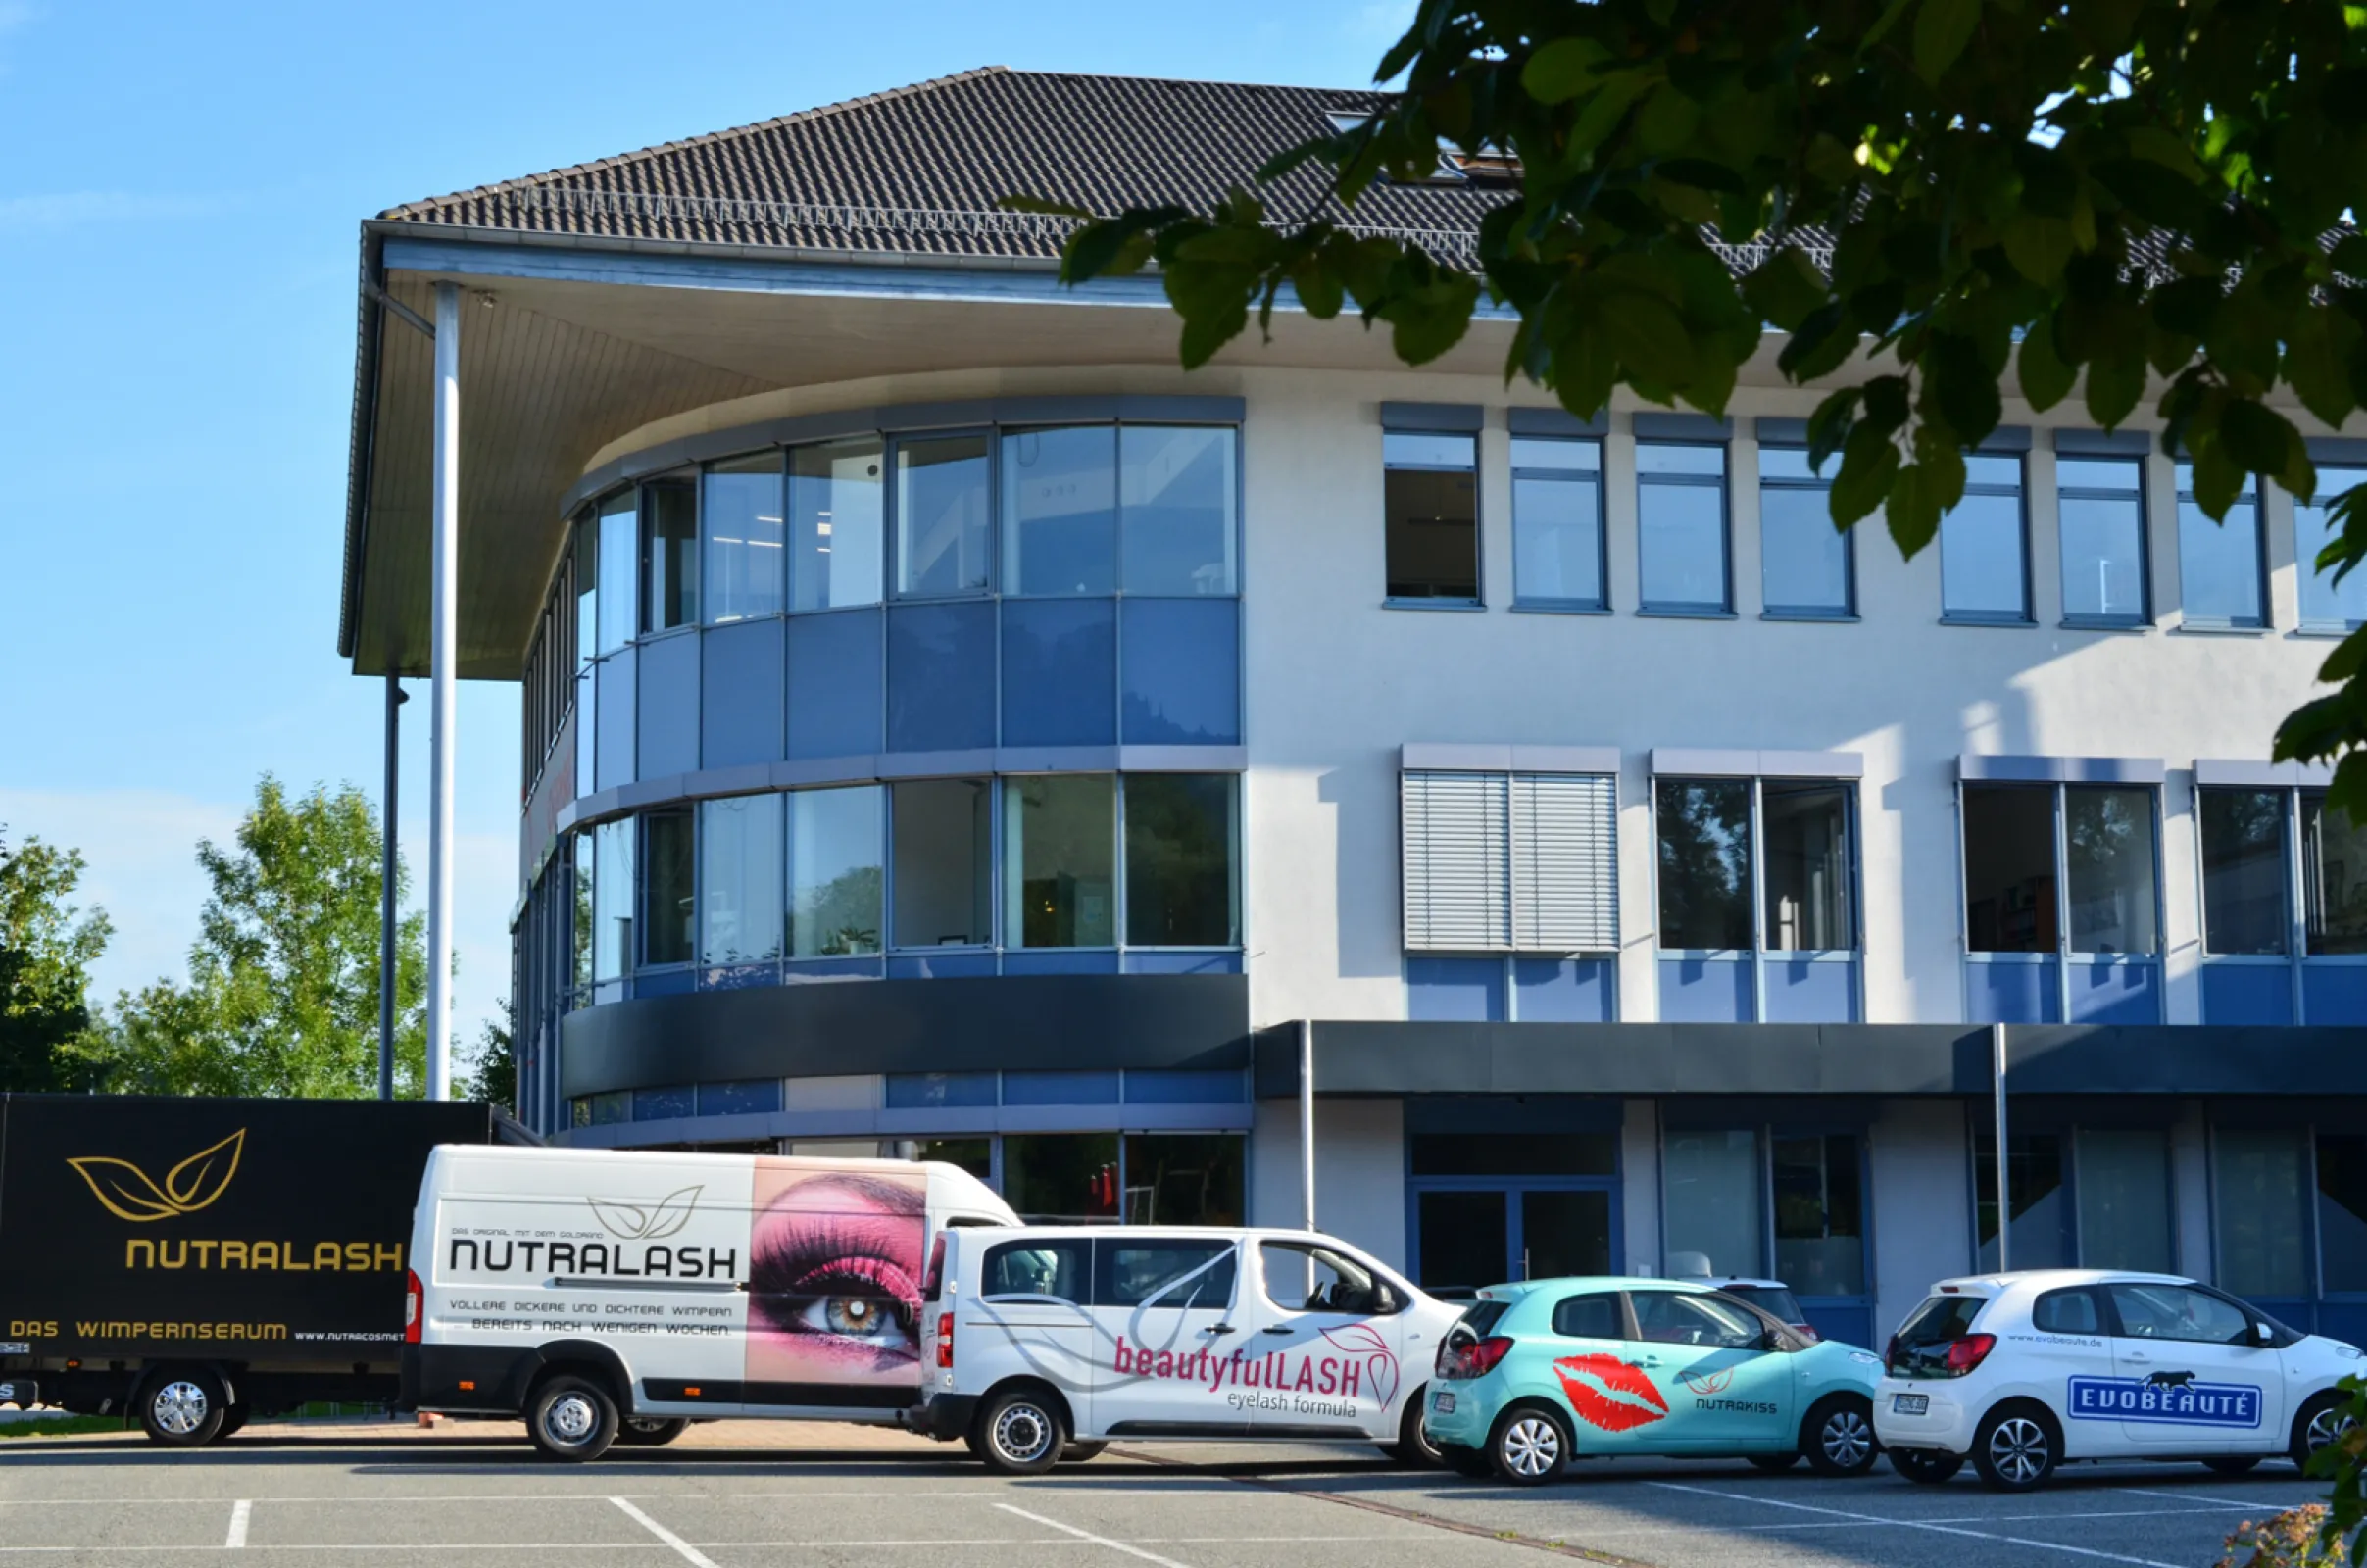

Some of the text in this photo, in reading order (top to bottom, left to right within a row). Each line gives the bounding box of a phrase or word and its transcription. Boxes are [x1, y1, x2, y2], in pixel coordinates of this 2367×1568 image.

[126, 1239, 403, 1271] NUTRALASH
[450, 1239, 736, 1279] NUTRALASH
[450, 1299, 733, 1317] VOLLERE DICKERE UND DICHTERE WIMPERN
[10, 1320, 287, 1341] DAS WIMPERNSERUM
[294, 1332, 406, 1342] WWW.NUTRACOSMET
[471, 1318, 532, 1331] BEREITS
[542, 1320, 581, 1332] NACH
[591, 1322, 658, 1334] WENIGEN
[1114, 1335, 1360, 1397] beautyfulLASH
[1227, 1391, 1356, 1418] eyelash formula
[1696, 1398, 1778, 1414] NUTRAKISS
[2081, 1388, 2248, 1416] EVOBEAUTÉ
